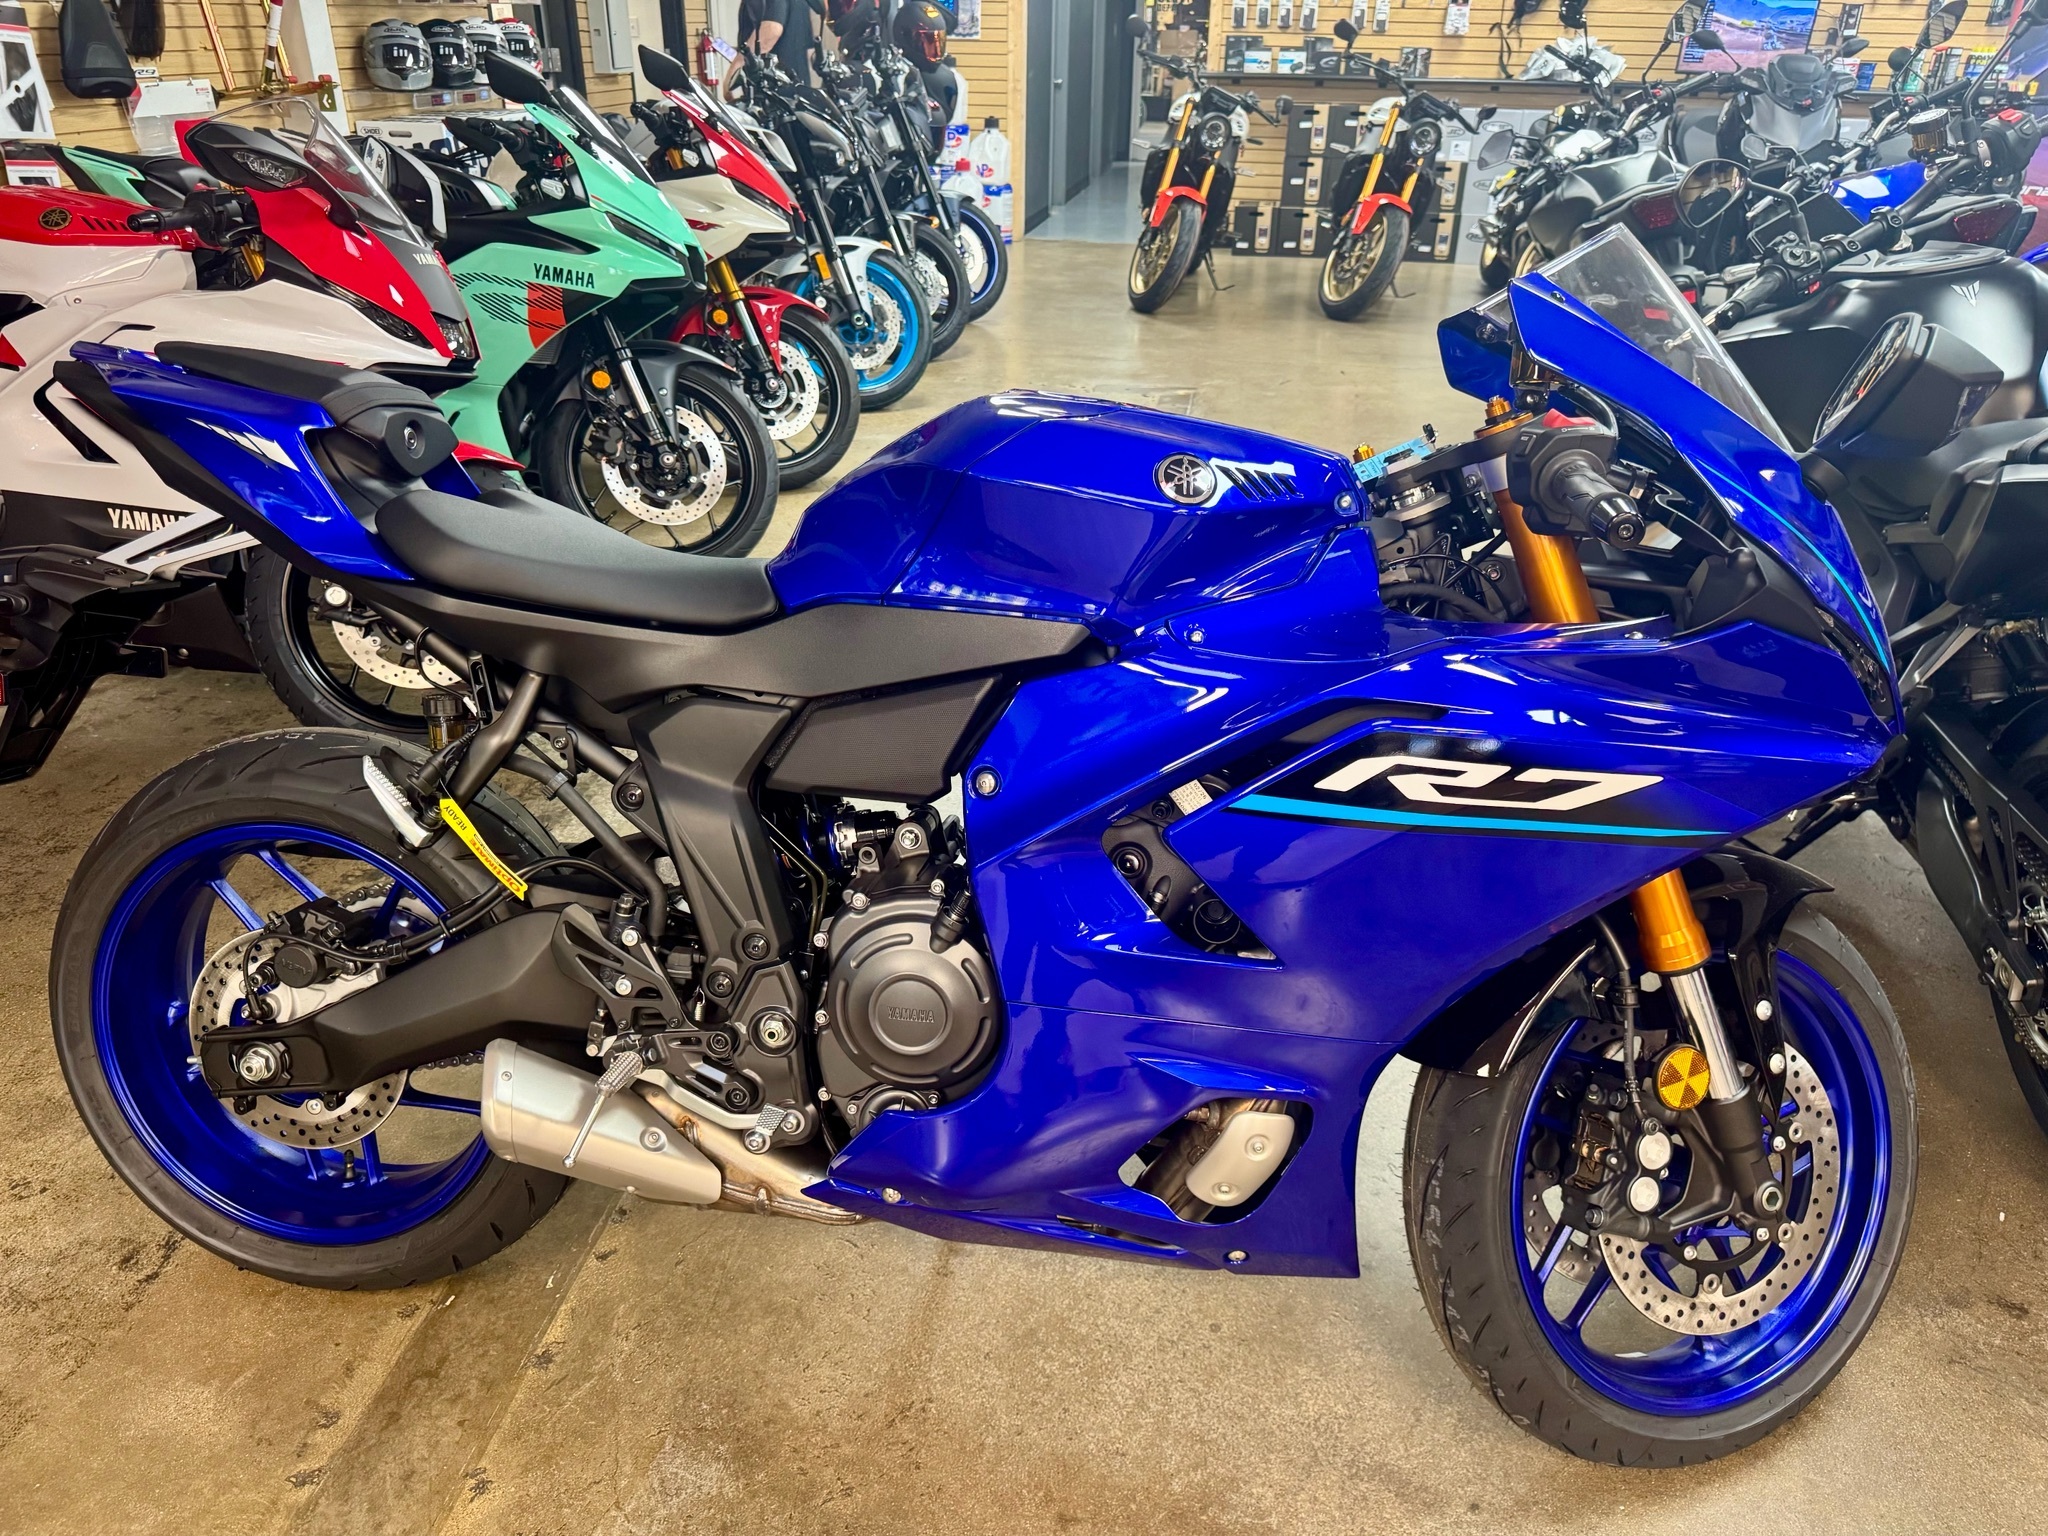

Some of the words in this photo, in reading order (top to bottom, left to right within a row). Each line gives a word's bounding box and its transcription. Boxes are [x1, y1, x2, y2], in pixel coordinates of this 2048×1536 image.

[533, 263, 596, 289] YAMAHA
[107, 507, 187, 532] YAMAH
[1313, 755, 1664, 811] R7
[443, 804, 467, 831] READY
[886, 1006, 935, 1023] YAMAHA
